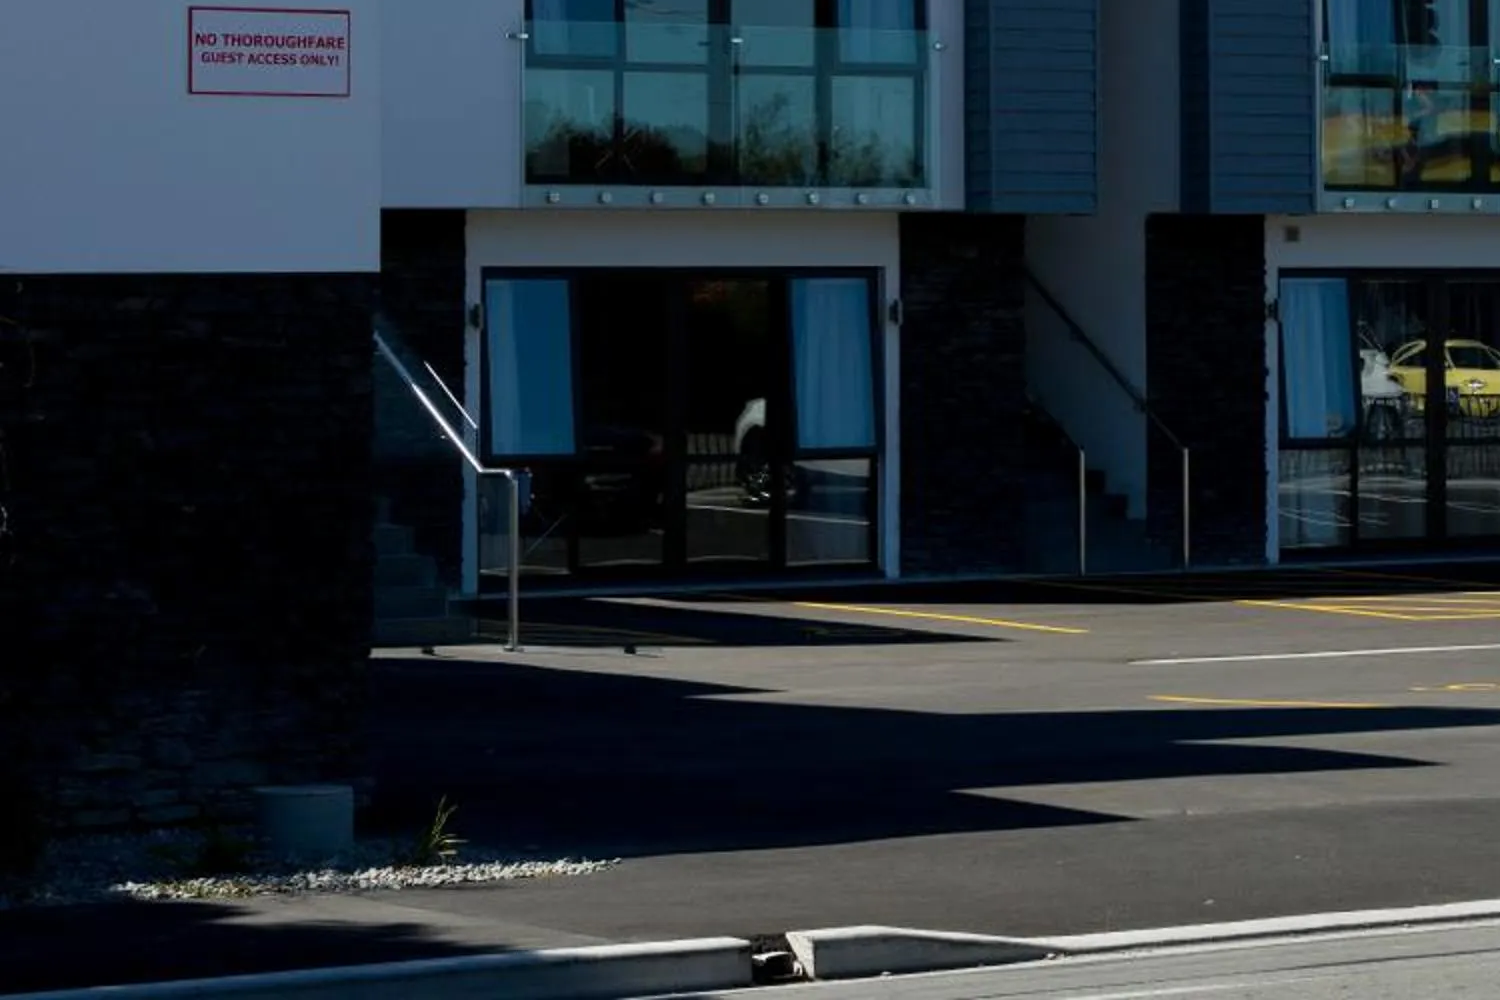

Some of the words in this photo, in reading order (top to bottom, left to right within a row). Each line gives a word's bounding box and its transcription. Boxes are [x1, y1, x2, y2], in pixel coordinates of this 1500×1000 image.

[195, 33, 217, 47] NO
[222, 33, 345, 49] THOROUGHFARE
[201, 51, 243, 63] GUEST
[248, 53, 297, 65] ACCESS
[301, 54, 339, 66] ONLY!
